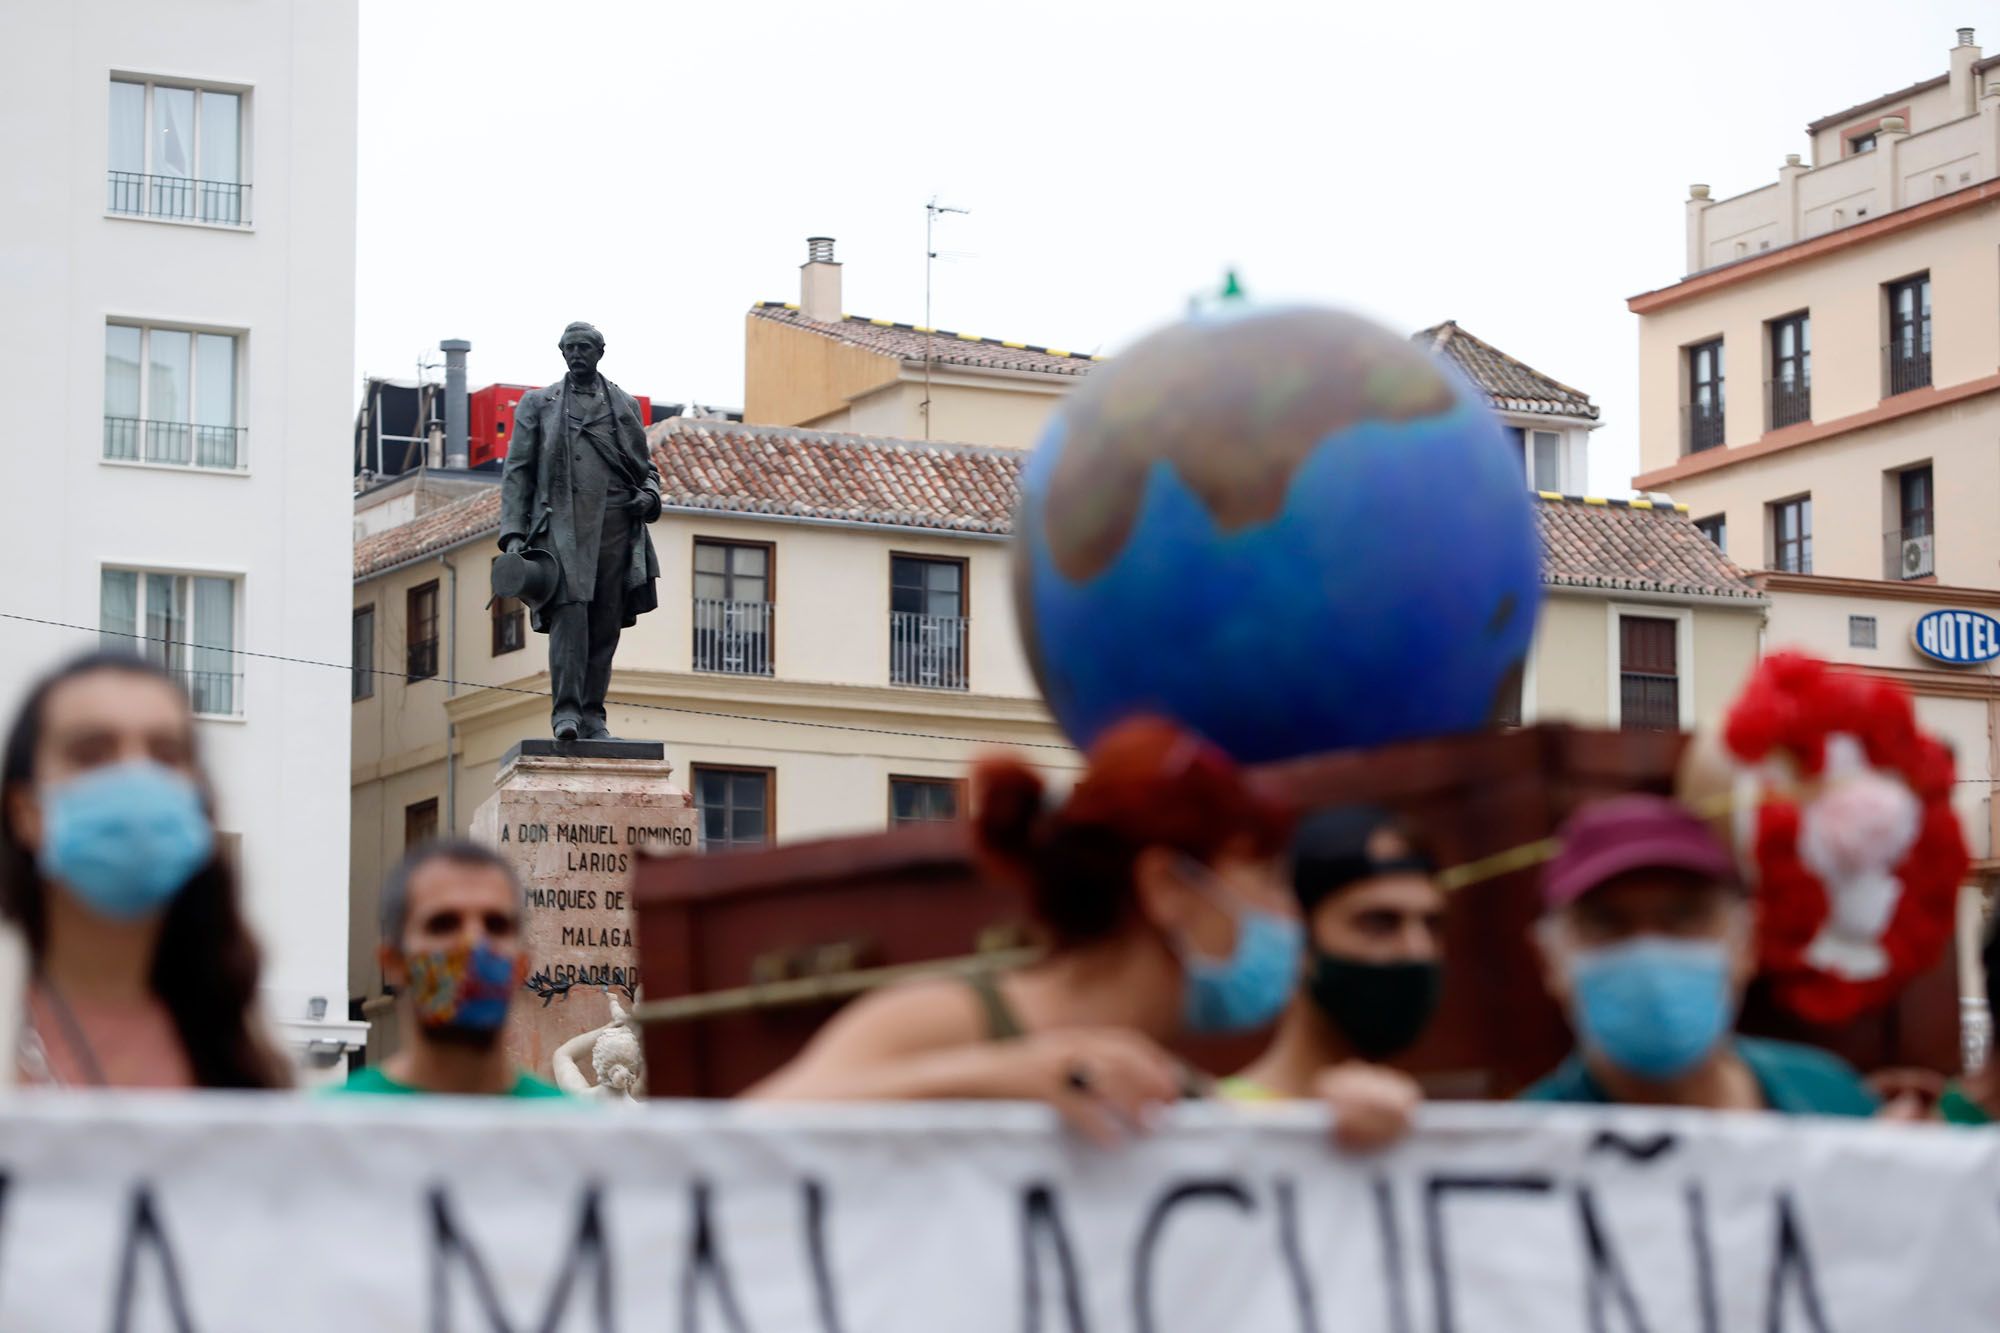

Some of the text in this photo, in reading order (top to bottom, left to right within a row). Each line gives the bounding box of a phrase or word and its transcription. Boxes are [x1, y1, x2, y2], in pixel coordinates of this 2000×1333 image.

[1921, 612, 2000, 661] HOTEL
[501, 823, 692, 847] A DON MANUEL DOMINGO
[567, 852, 628, 873] LARIOS
[524, 888, 597, 911] MARQUES
[605, 890, 625, 910] DE
[562, 926, 633, 948] MALAGA
[544, 963, 639, 986] AGRDCID
